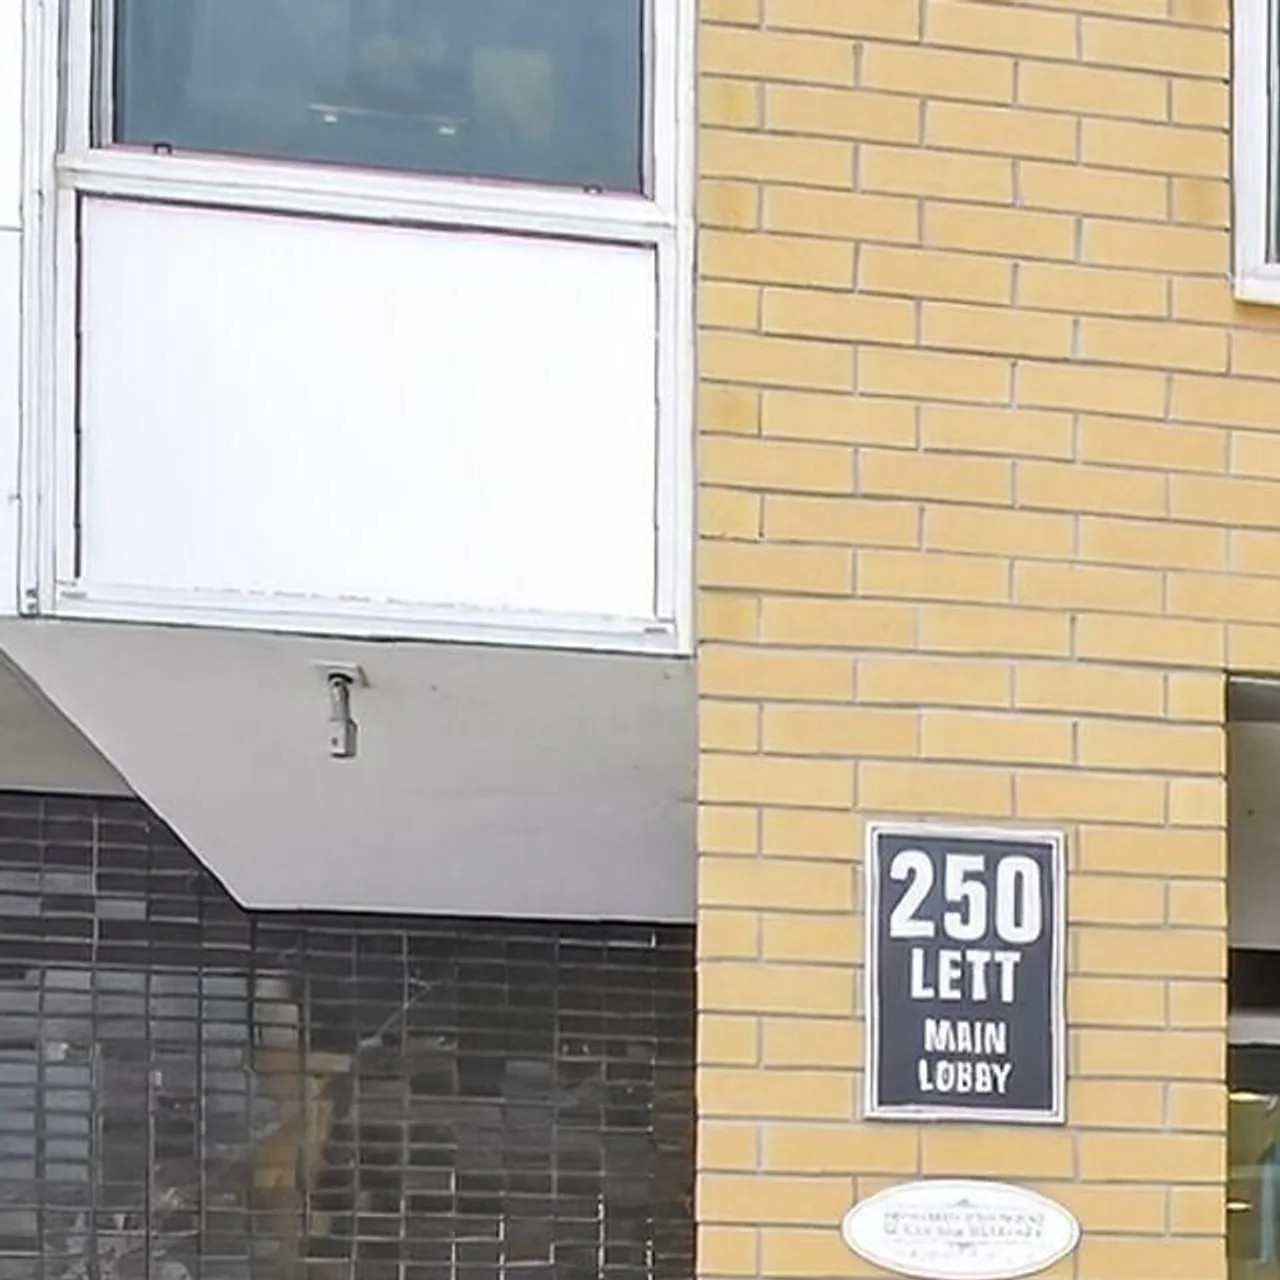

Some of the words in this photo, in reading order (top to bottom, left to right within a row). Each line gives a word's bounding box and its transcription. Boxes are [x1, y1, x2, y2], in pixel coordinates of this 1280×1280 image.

[888, 849, 1042, 944] 250
[911, 947, 1021, 1003] LETT
[924, 1017, 1007, 1055] MAIN
[917, 1058, 1013, 1095] LOBBY
